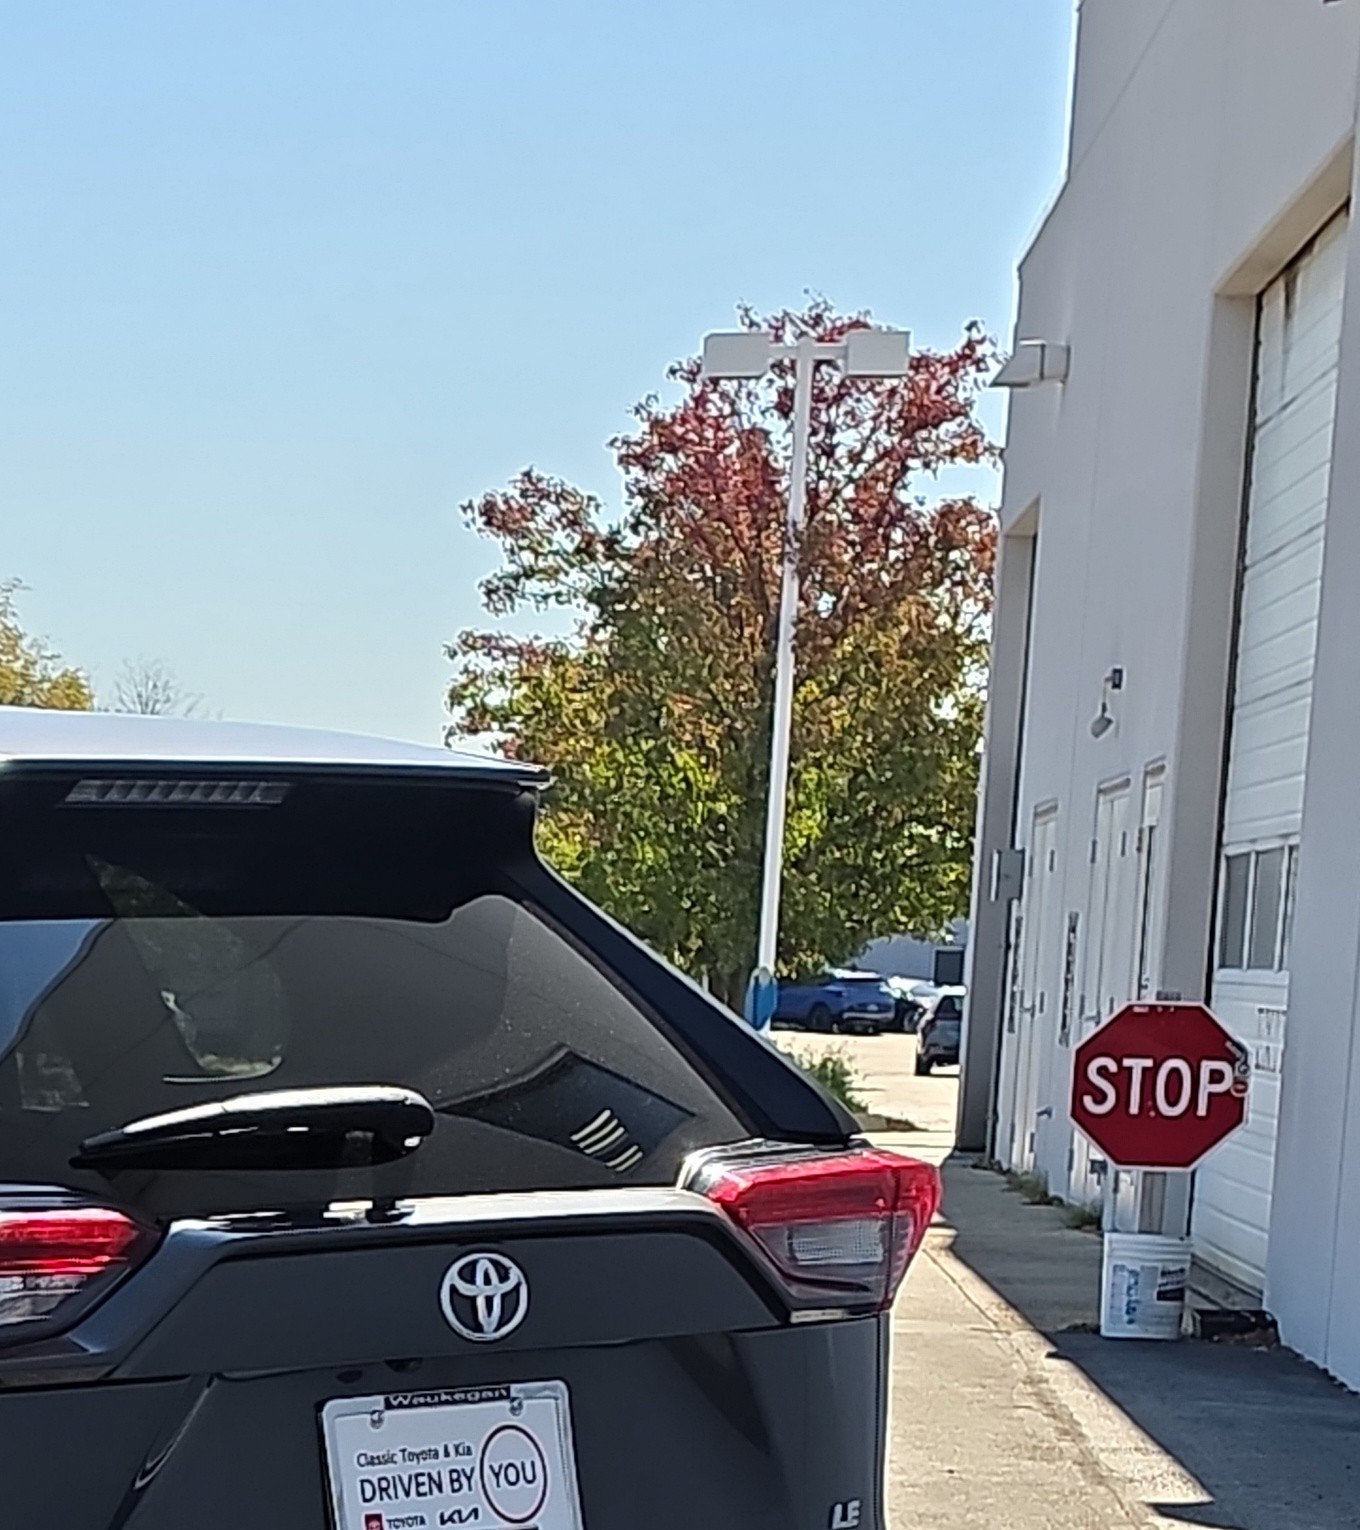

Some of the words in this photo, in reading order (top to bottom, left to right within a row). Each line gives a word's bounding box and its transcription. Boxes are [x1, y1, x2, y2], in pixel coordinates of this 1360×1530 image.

[1082, 1057, 1234, 1117] STOP
[356, 1450, 398, 1468] Classic
[398, 1447, 440, 1465] Toyota
[453, 1442, 473, 1458] Kia
[359, 1470, 444, 1503] DRIVEN
[448, 1466, 476, 1494] BY
[488, 1460, 537, 1488] YOU
[385, 1515, 427, 1530] TOYOTA
[831, 1499, 860, 1530] LE
